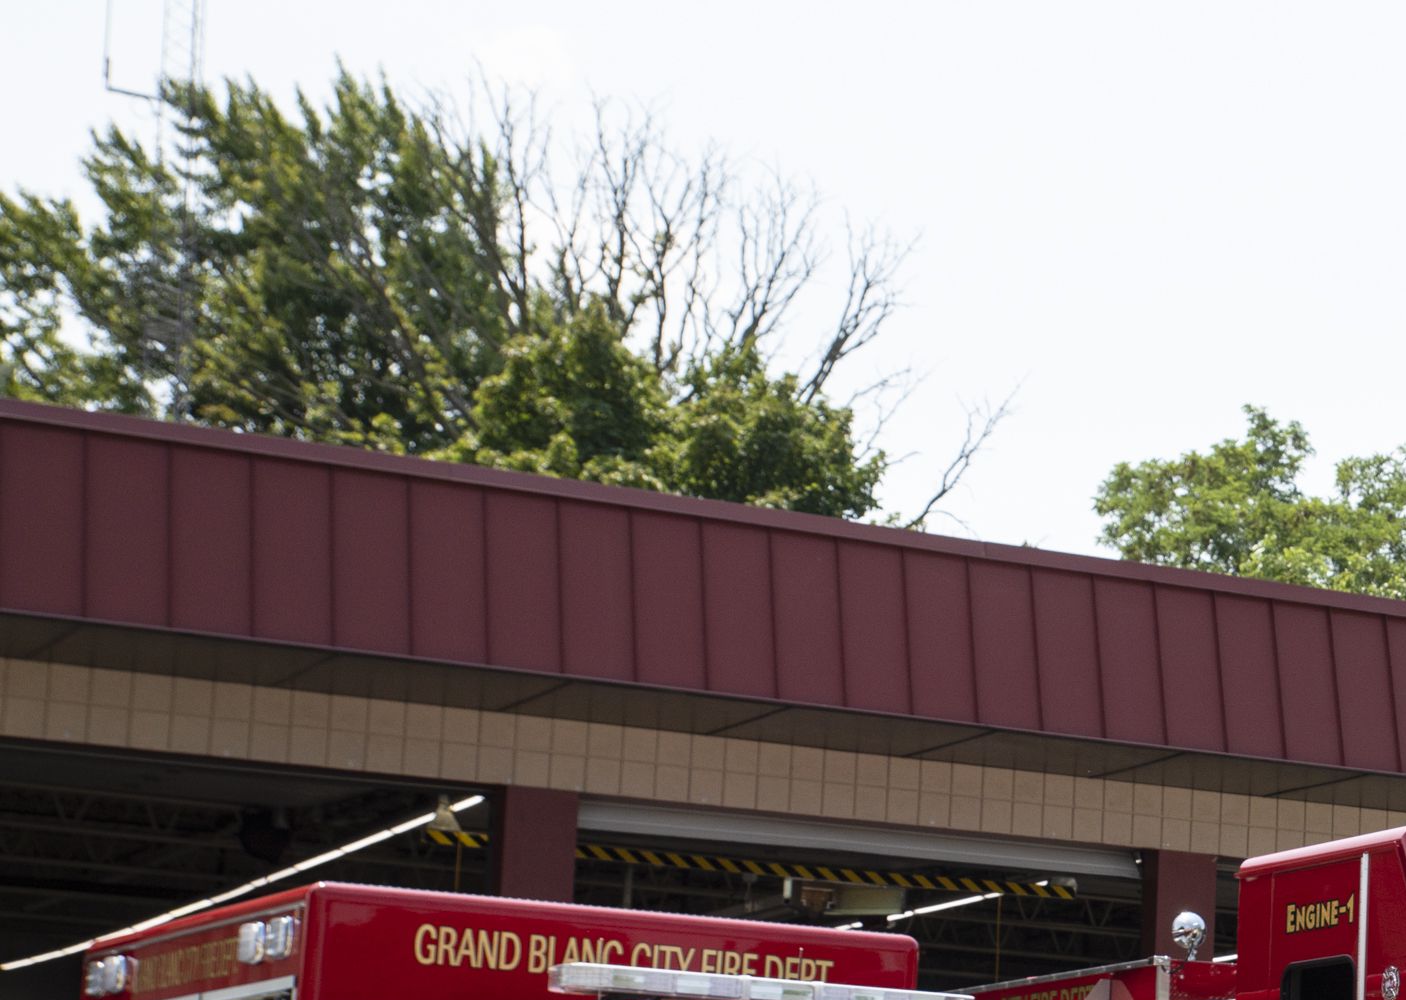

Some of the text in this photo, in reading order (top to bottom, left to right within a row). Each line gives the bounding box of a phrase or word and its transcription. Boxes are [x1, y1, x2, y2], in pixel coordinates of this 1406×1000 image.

[1286, 893, 1354, 933] ENGINE-1
[414, 923, 834, 983] GRAND BLANC CITY FIRE DEPT
